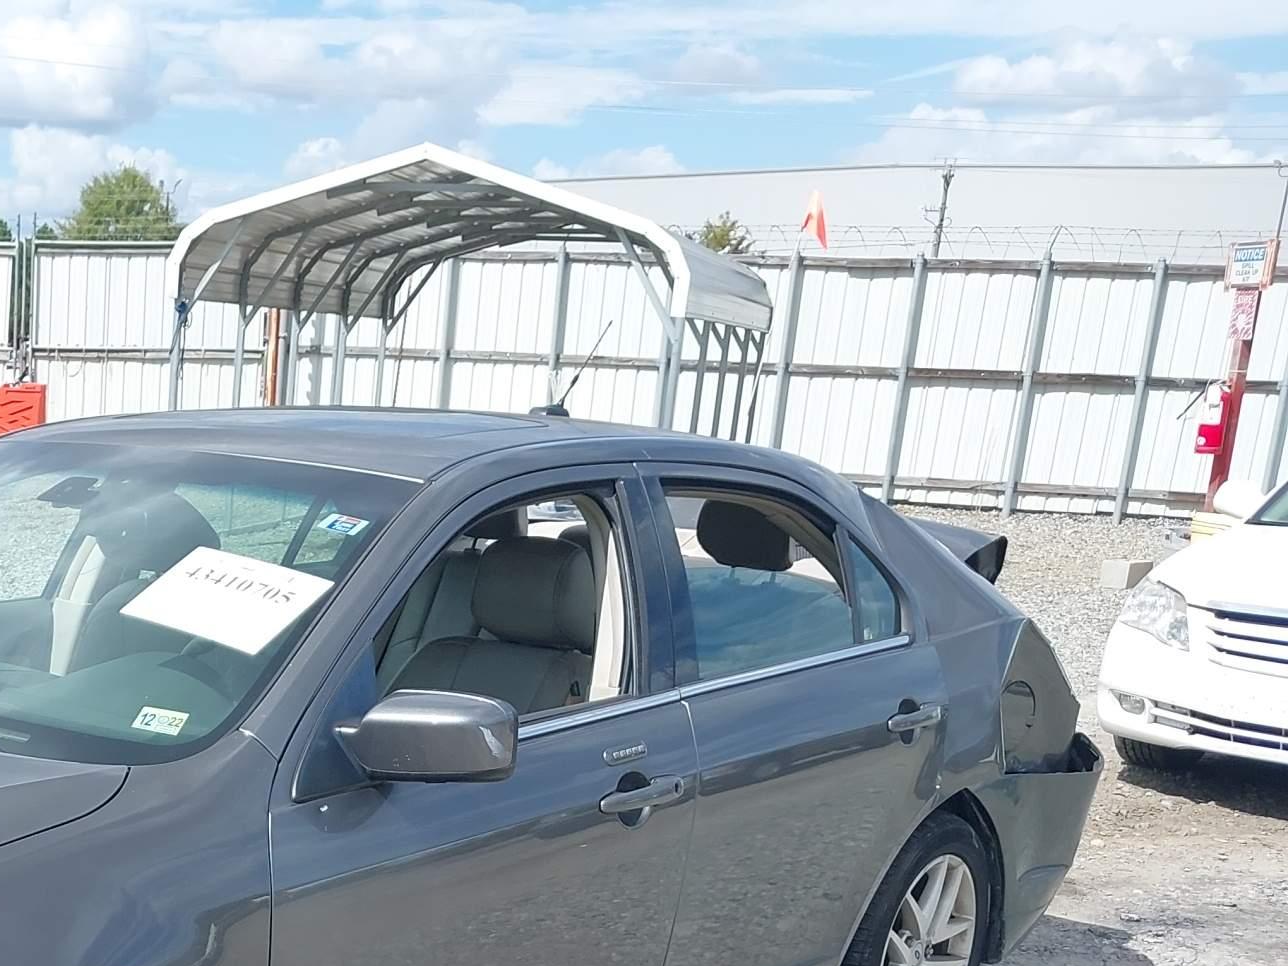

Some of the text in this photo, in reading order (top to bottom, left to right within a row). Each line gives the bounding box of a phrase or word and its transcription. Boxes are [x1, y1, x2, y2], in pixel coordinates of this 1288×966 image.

[1235, 248, 1264, 260] NOTICE
[185, 567, 296, 603] 43410705
[139, 712, 157, 726] 12
